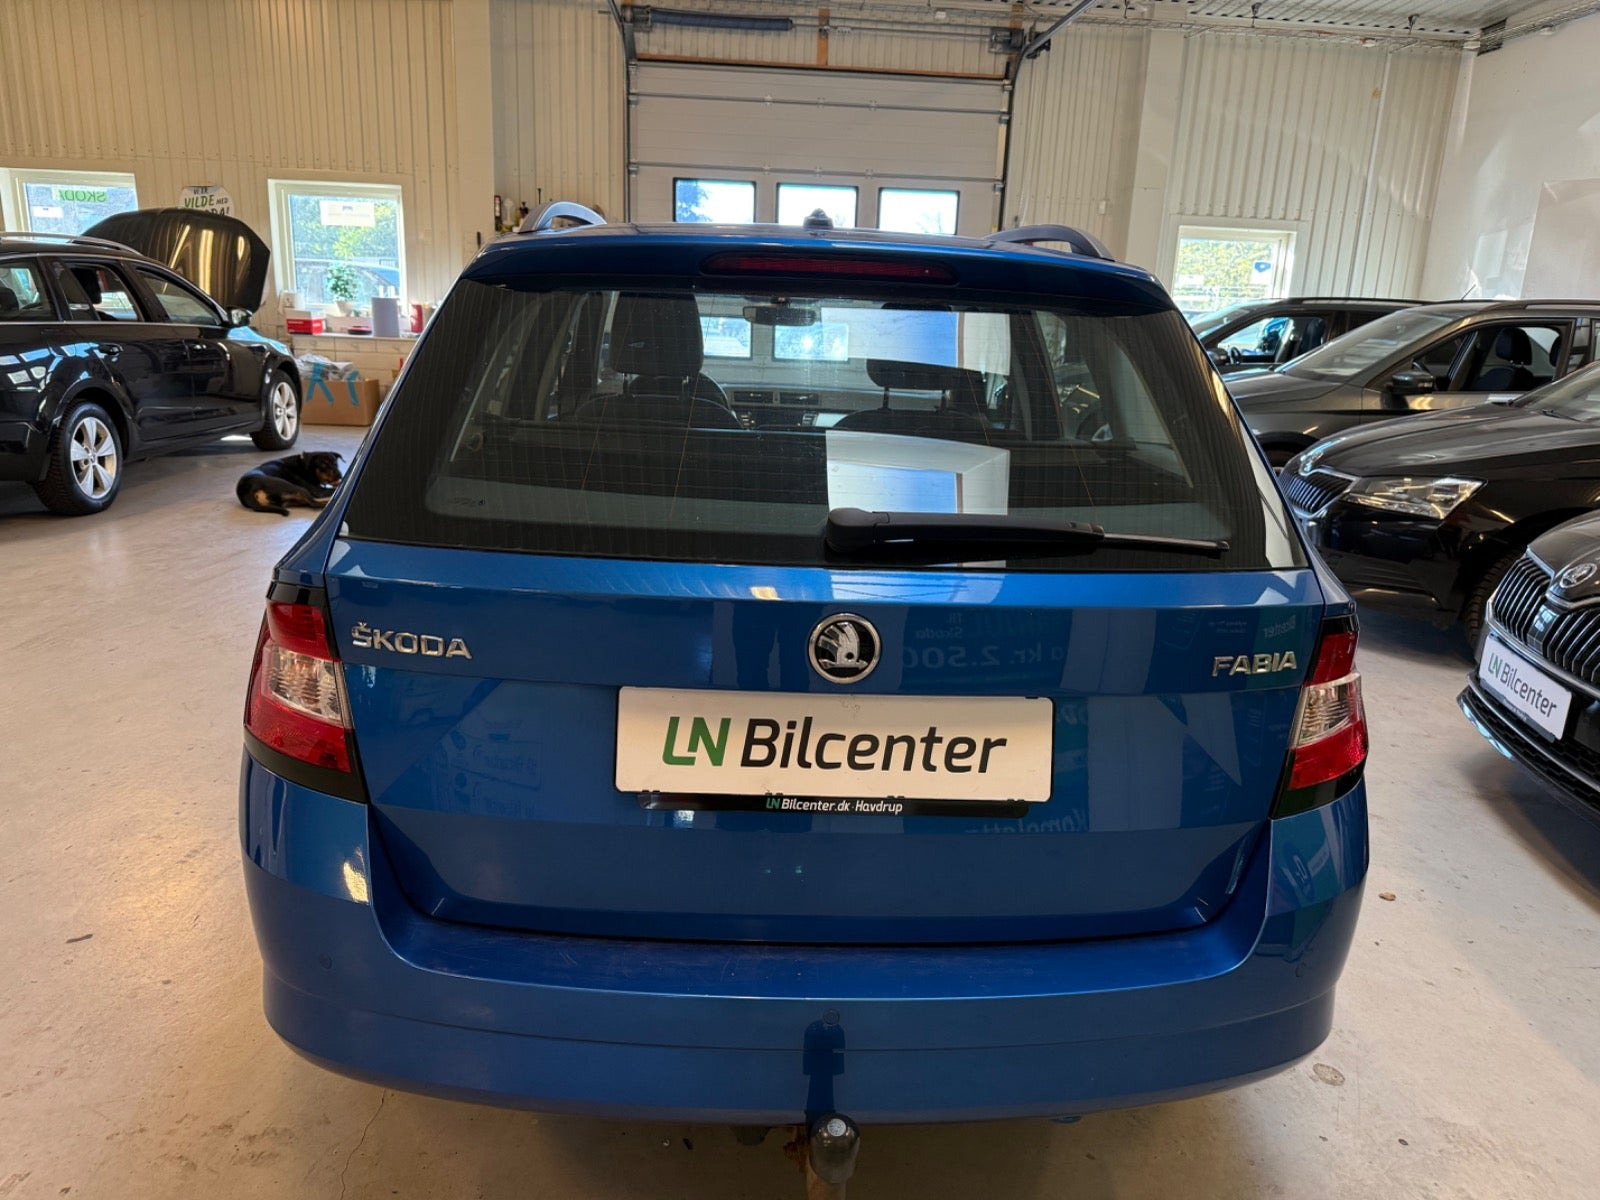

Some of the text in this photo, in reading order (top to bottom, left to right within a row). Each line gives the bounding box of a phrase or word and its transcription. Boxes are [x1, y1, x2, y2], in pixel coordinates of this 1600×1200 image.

[184, 194, 215, 209] VILDE
[351, 621, 473, 660] ŠKODA
[1212, 650, 1297, 677] FABIA
[1500, 662, 1557, 718] Bilcenter
[741, 716, 1007, 774] Bilcenter
[855, 800, 903, 815] Havdrup
